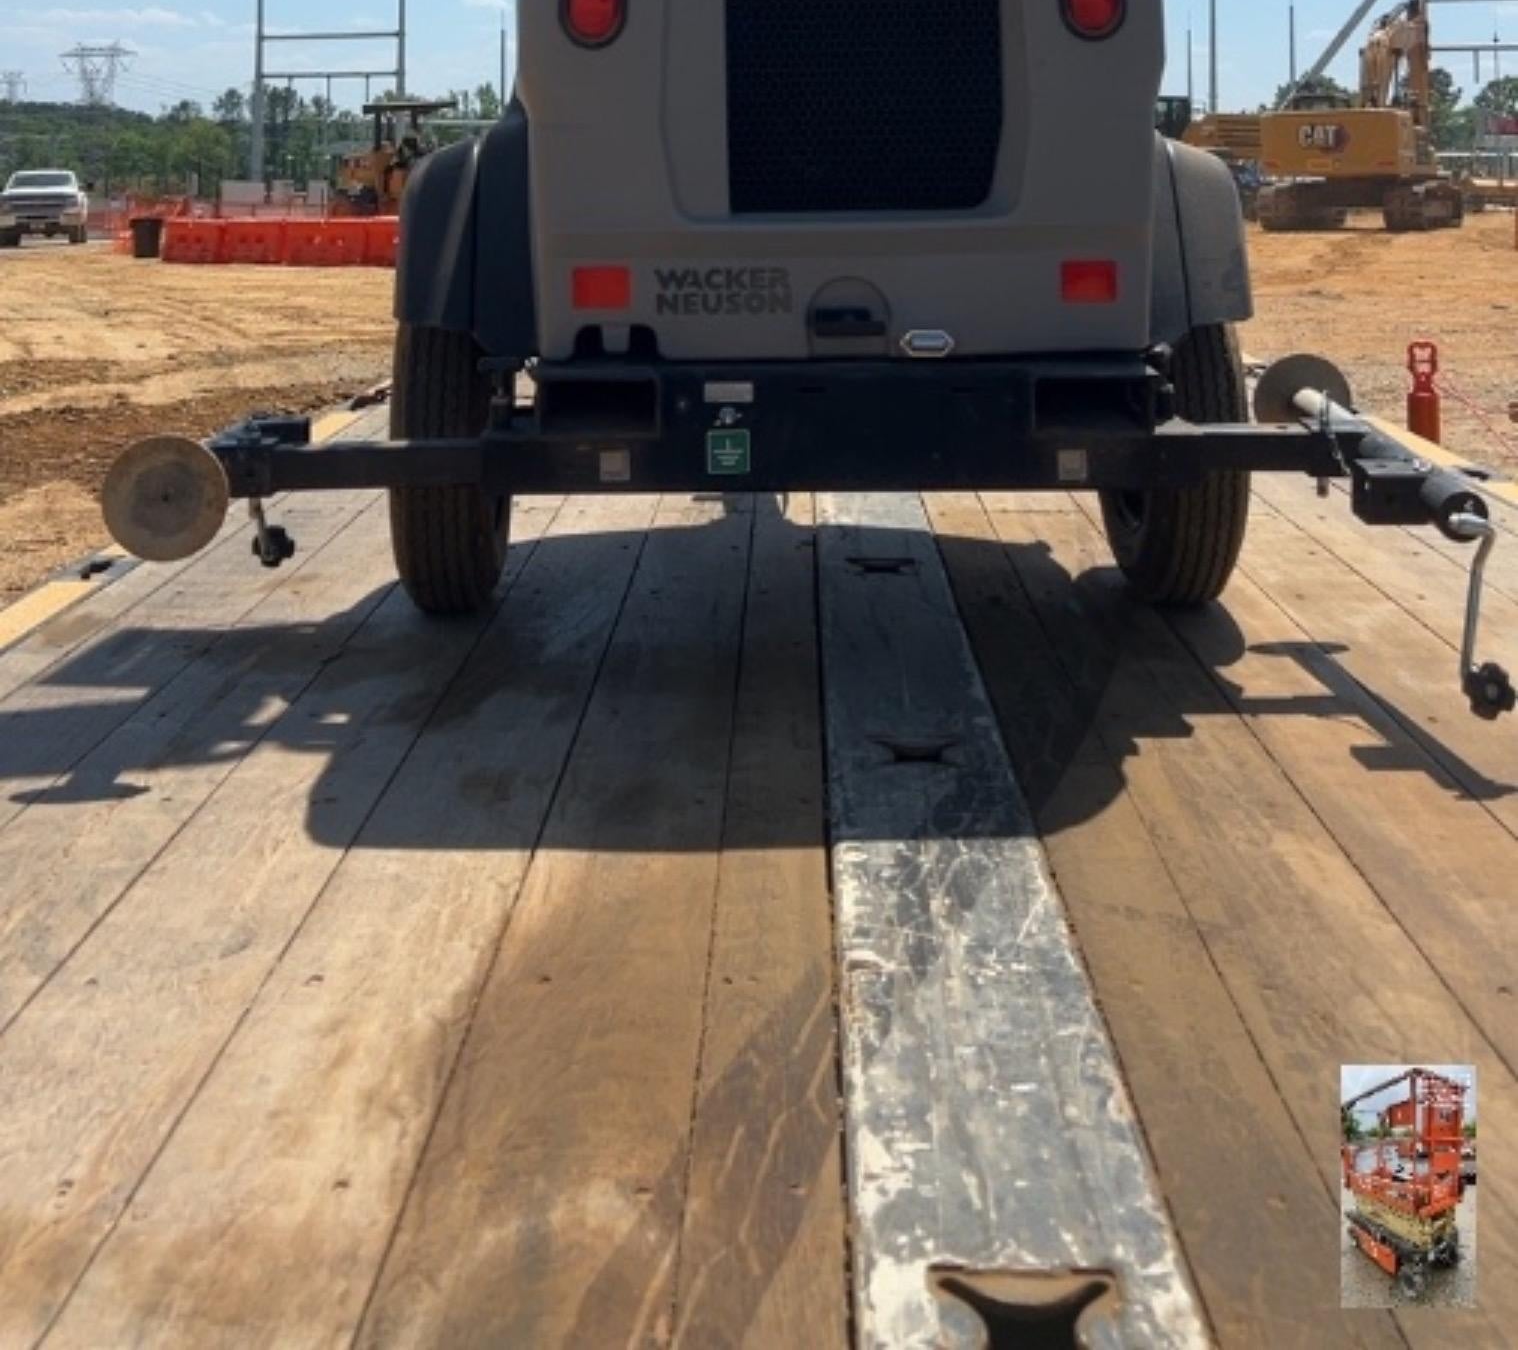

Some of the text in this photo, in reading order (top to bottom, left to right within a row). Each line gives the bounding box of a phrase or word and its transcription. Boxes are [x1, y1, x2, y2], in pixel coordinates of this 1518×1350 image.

[1298, 124, 1339, 148] CAT
[653, 266, 791, 290] WACKER
[655, 293, 793, 315] NEUSON
